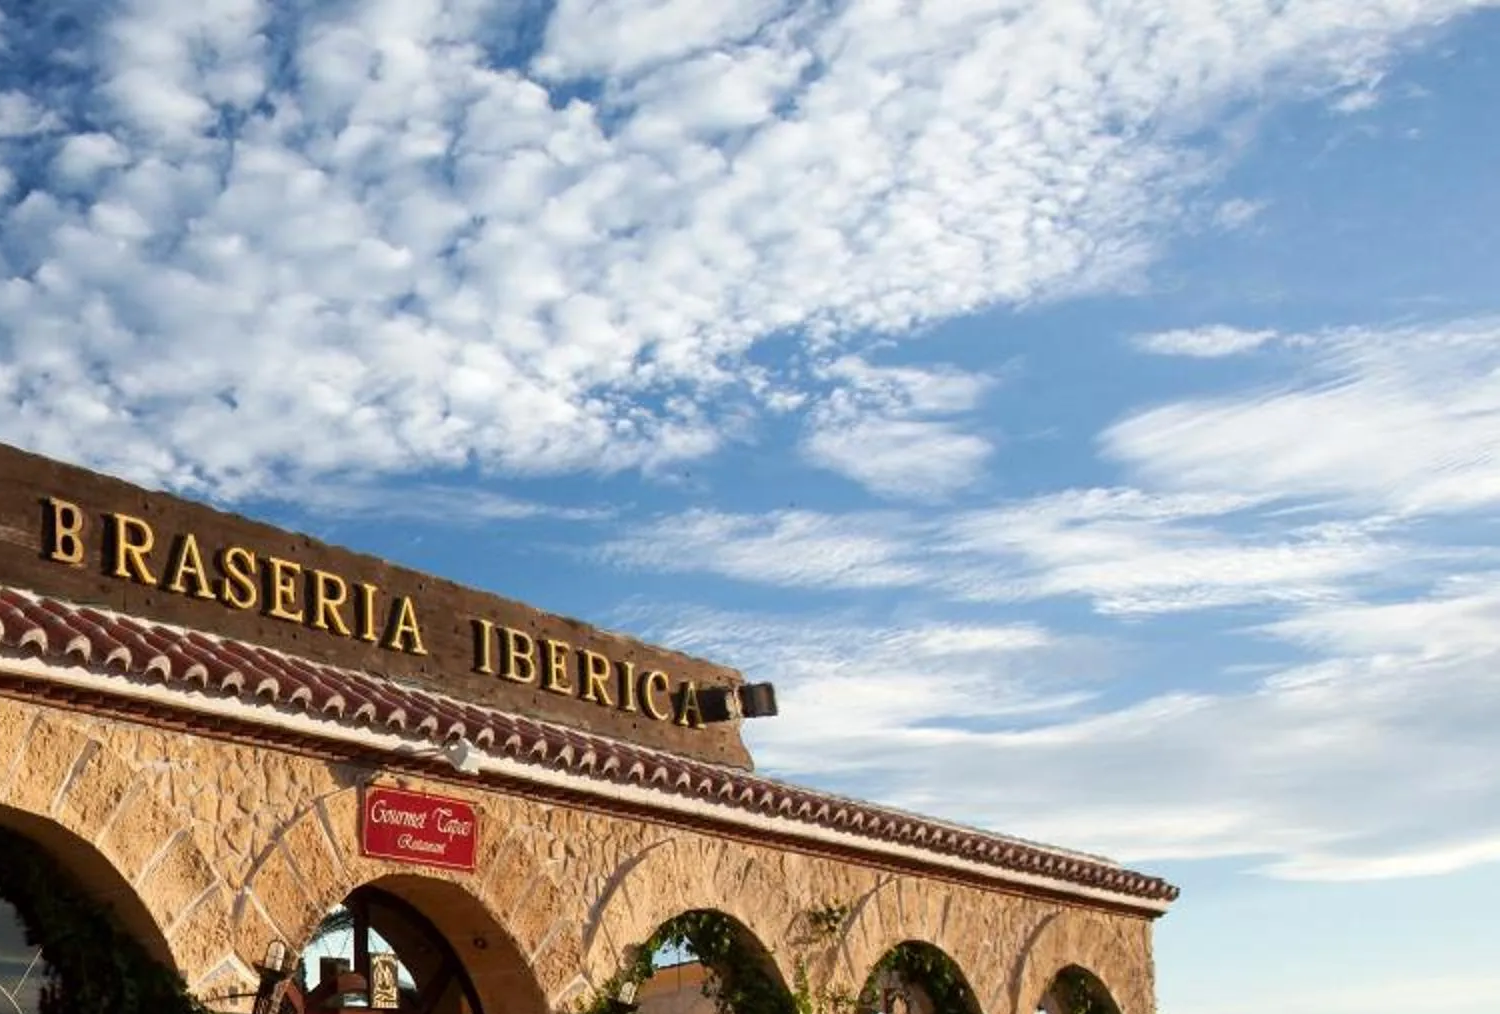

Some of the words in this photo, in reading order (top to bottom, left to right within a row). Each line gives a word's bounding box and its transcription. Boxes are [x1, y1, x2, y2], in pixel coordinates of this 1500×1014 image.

[49, 496, 428, 656] BRASERIA
[476, 618, 707, 730] IBERICA
[371, 799, 428, 829] Gourmet
[431, 807, 474, 842] Tapas
